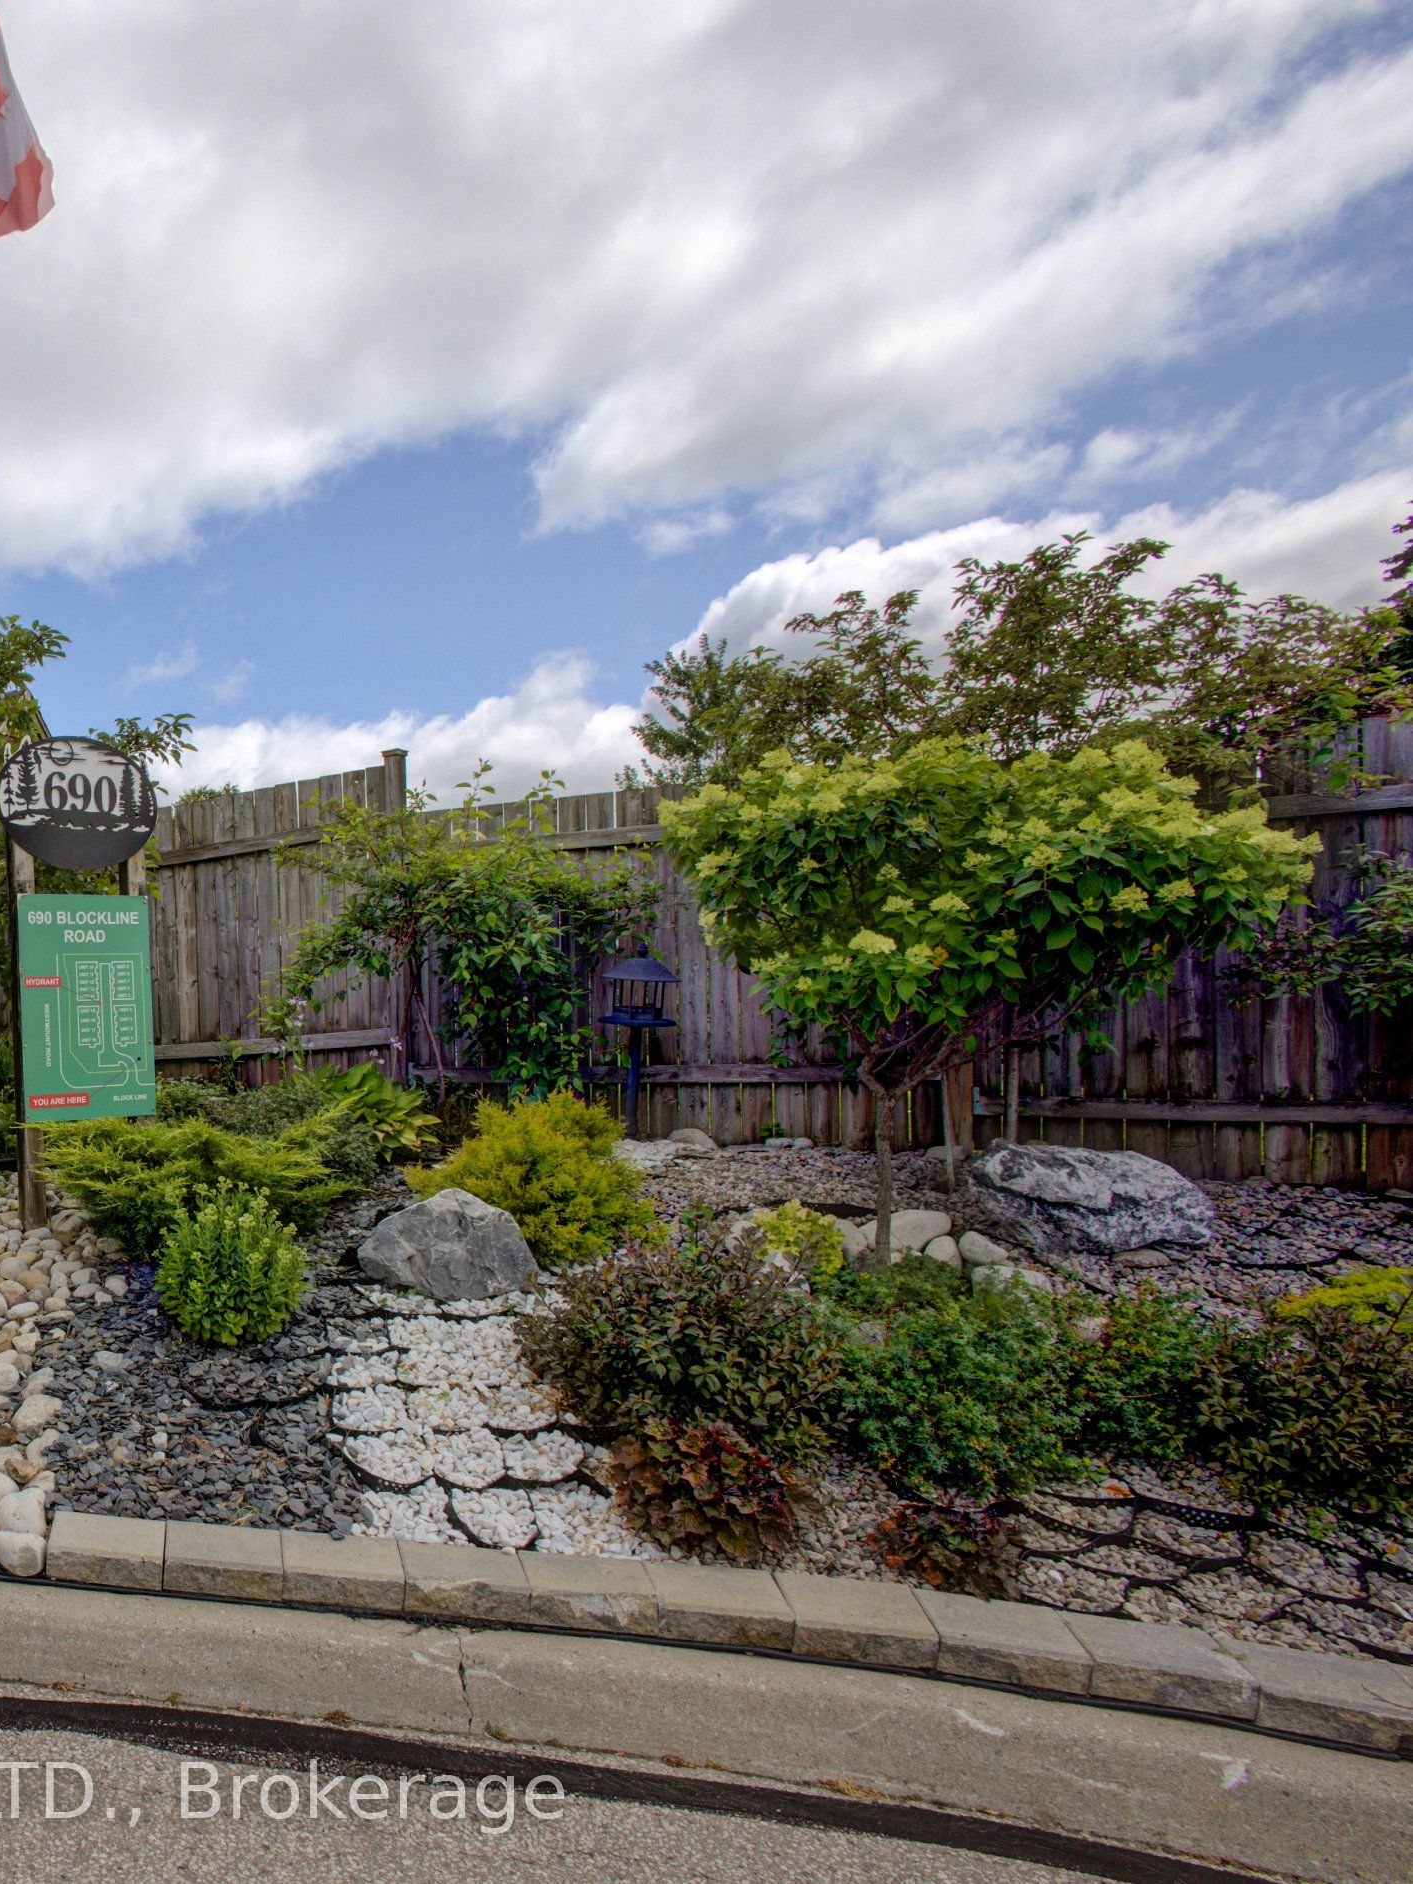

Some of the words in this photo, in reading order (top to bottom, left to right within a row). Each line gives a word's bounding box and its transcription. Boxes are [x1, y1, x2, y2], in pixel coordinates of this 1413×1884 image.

[44, 771, 117, 814] 690
[27, 911, 52, 925] 690
[56, 911, 140, 925] BLOCKLINE
[64, 930, 106, 943] ROAD
[26, 978, 60, 986] HYDRANT
[67, 1096, 87, 1104] HERE
